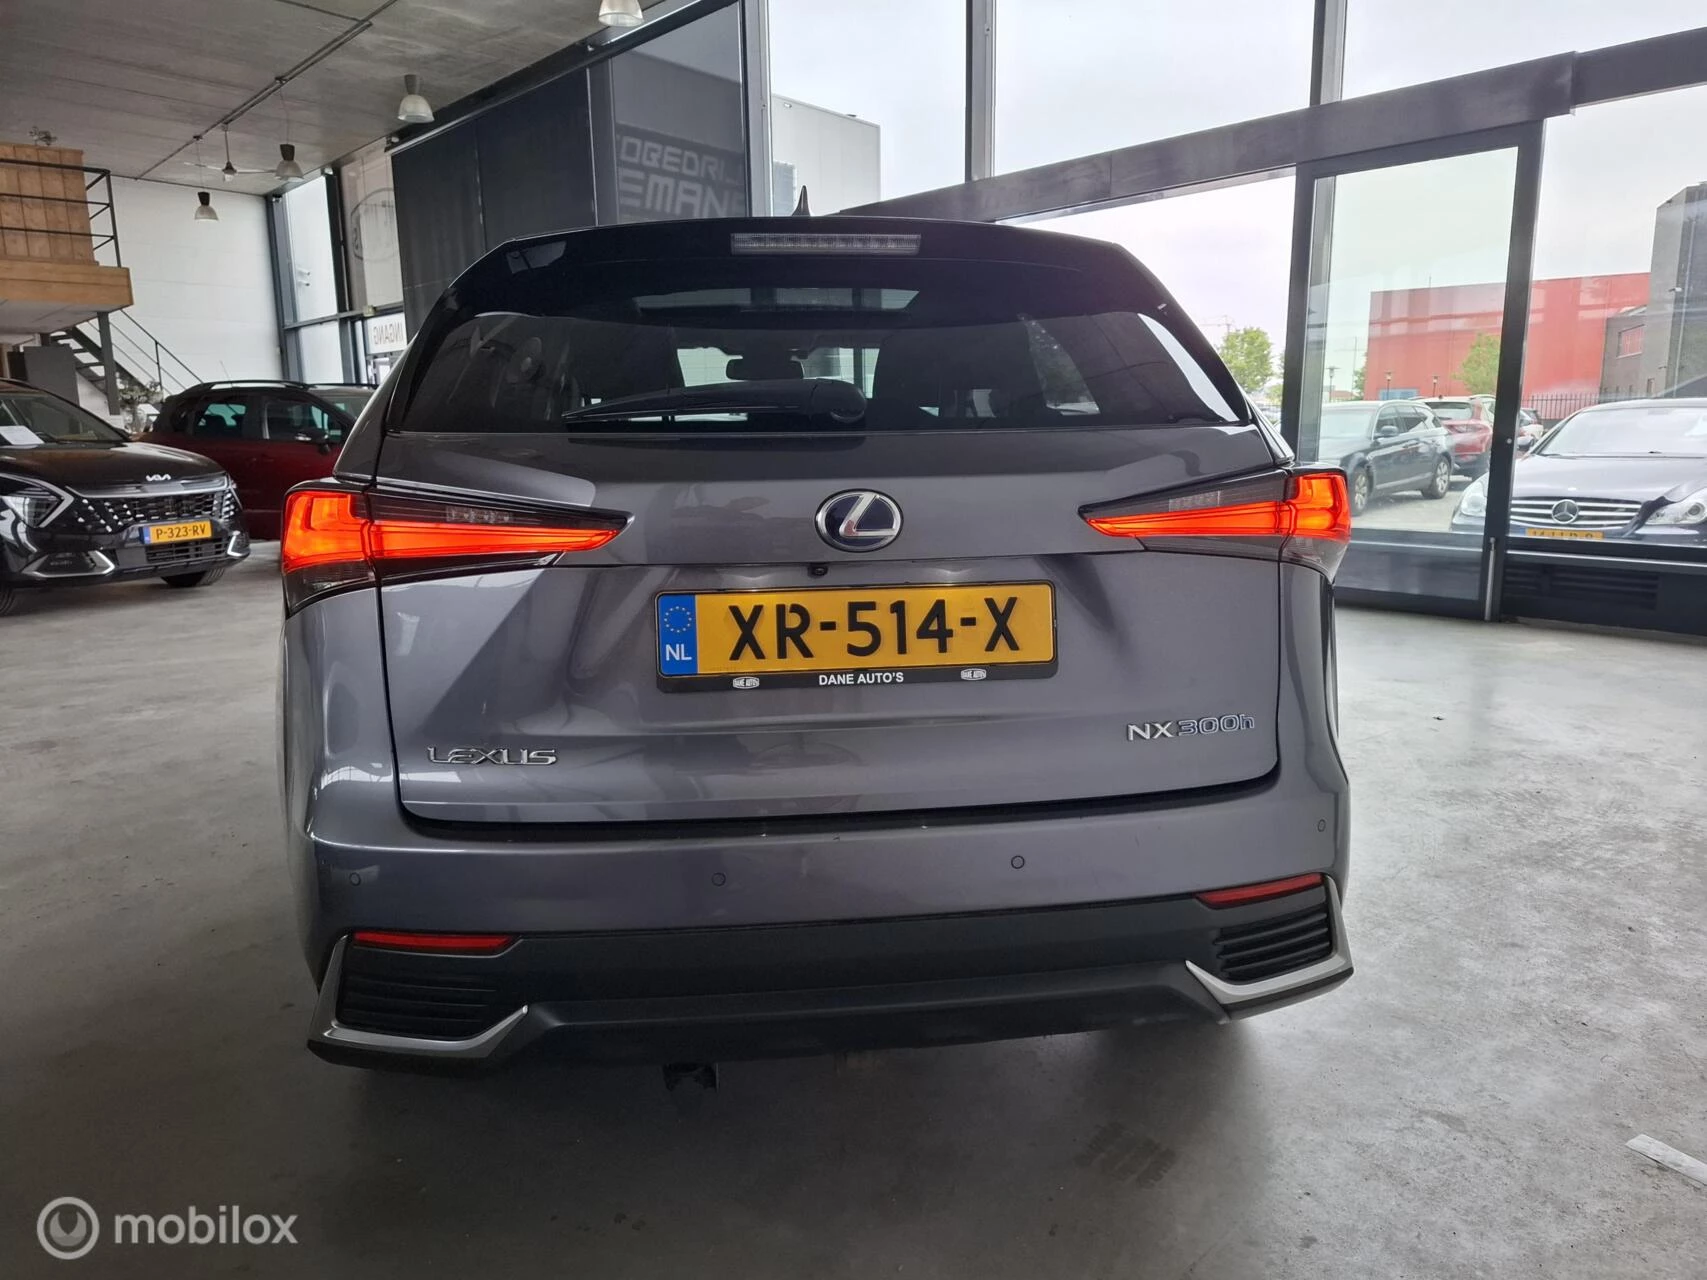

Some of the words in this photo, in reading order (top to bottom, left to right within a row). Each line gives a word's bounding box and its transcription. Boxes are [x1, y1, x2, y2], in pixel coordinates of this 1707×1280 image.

[155, 523, 207, 540] P-323-RV
[727, 596, 1021, 661] XR-514-X
[665, 643, 693, 661] NL
[818, 673, 856, 686] DANE
[858, 671, 905, 685] AUTO'S
[427, 746, 557, 765] LEXUS
